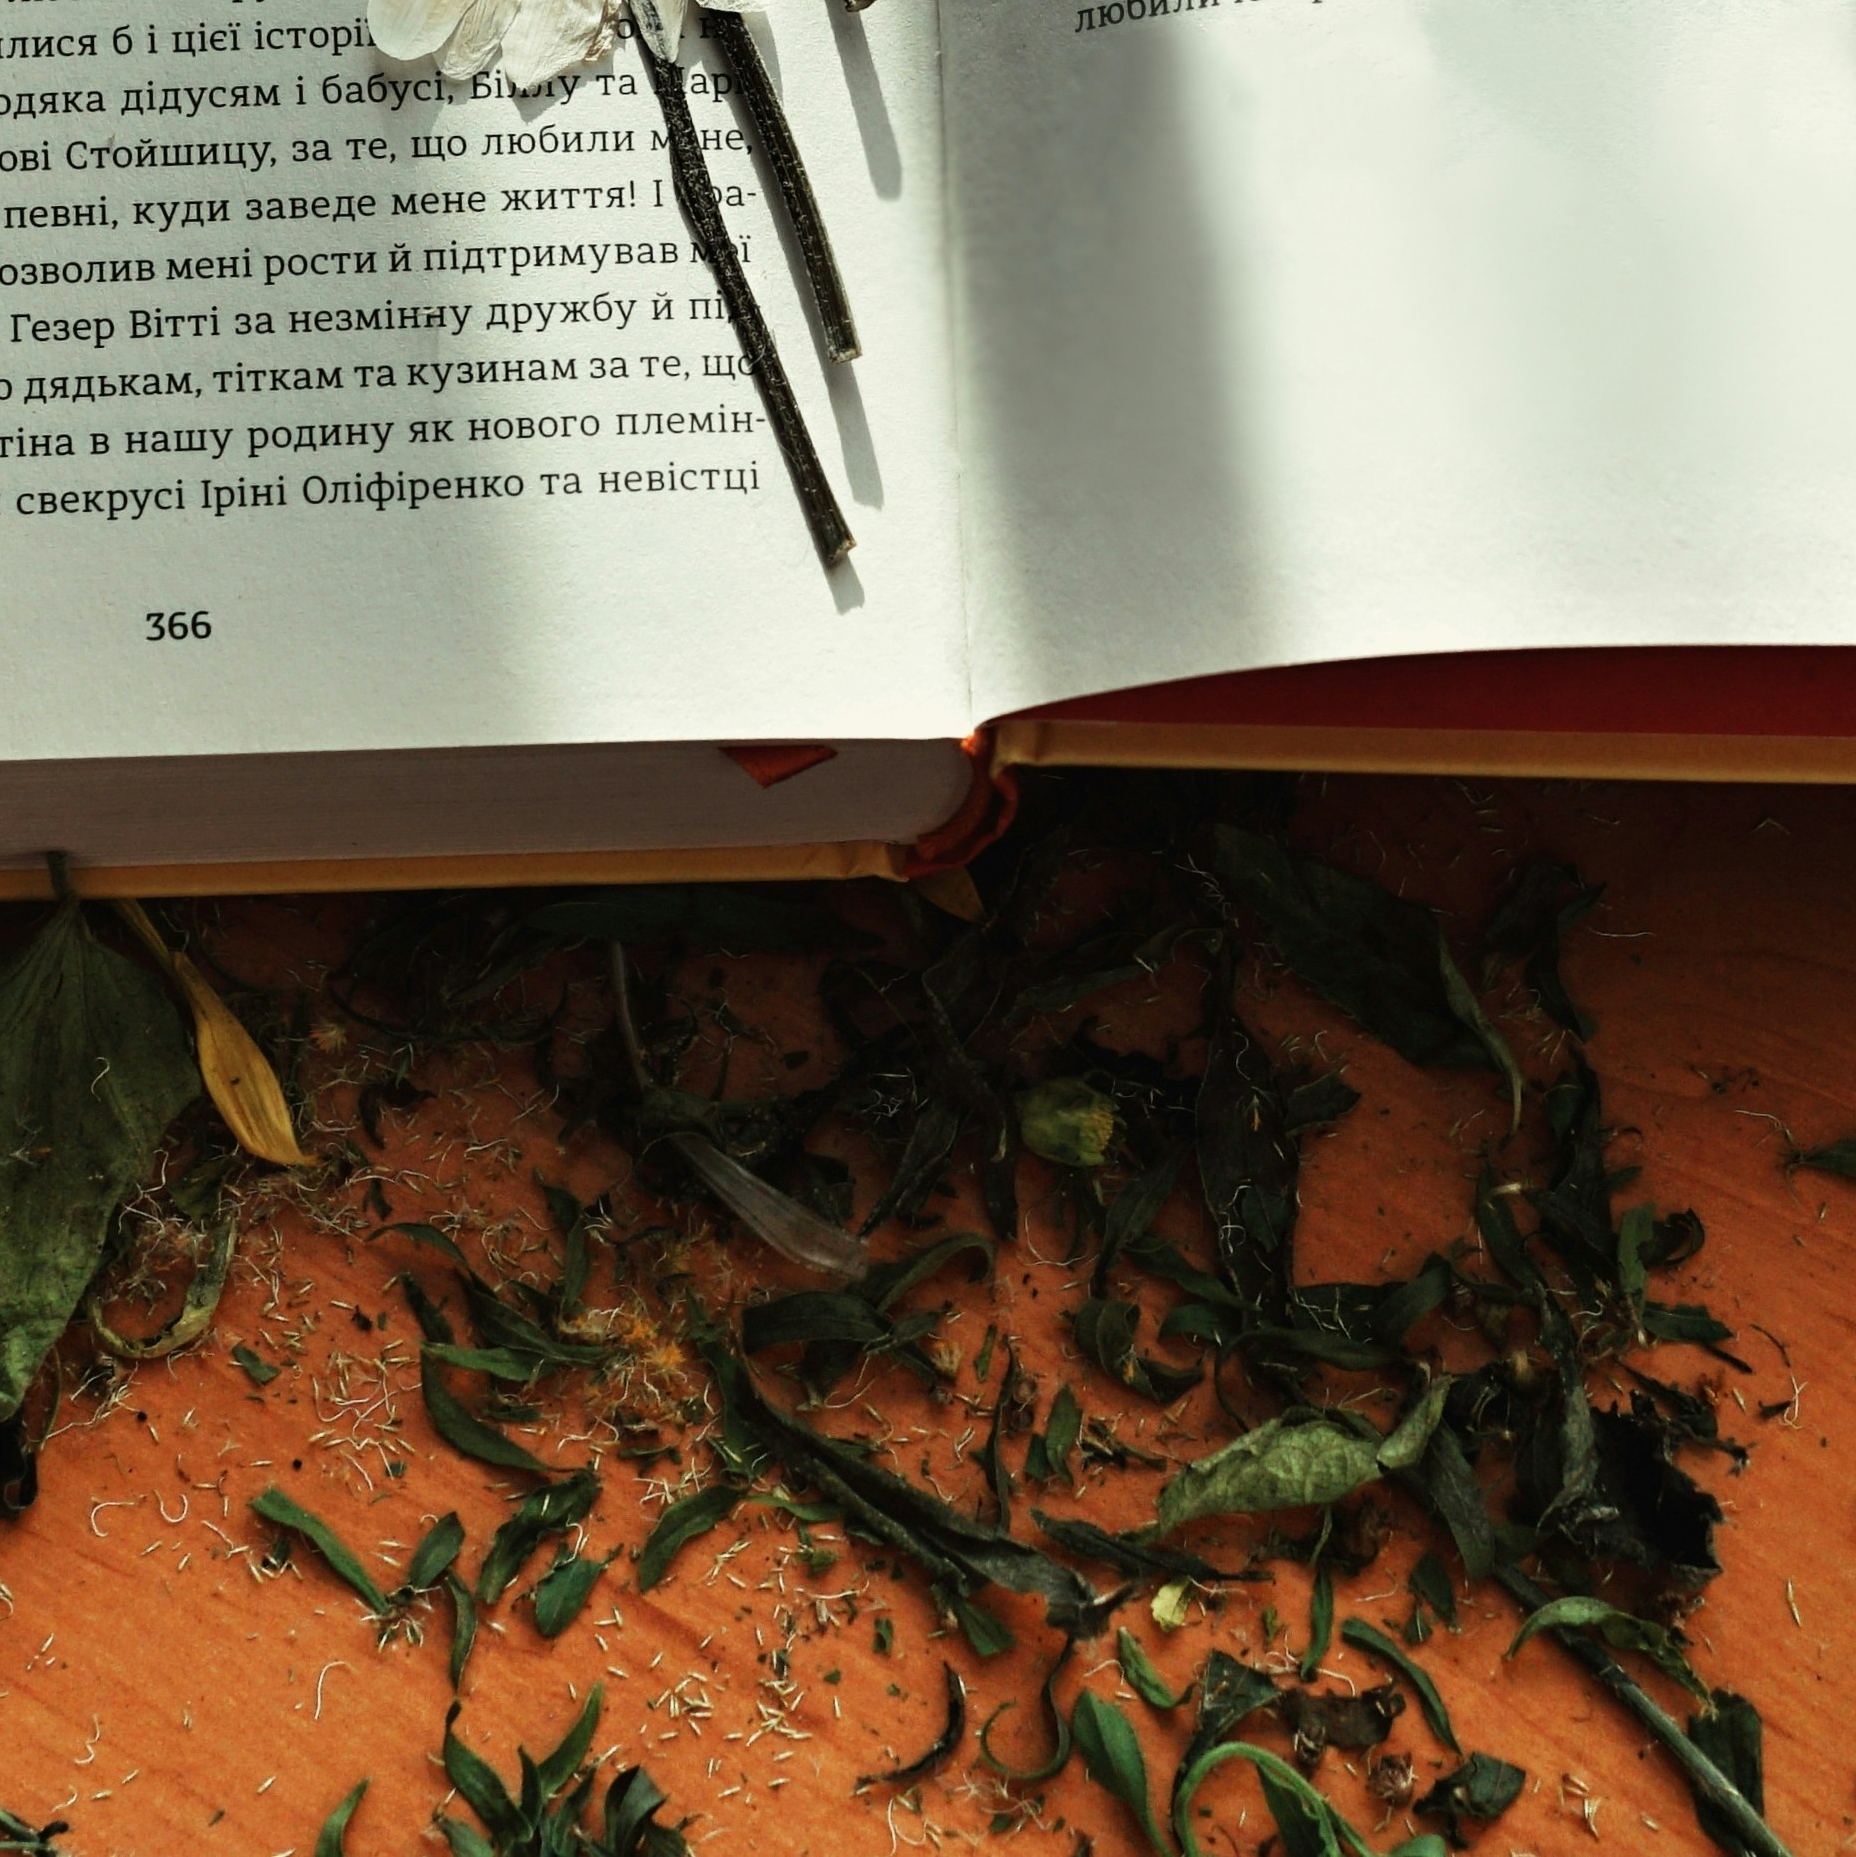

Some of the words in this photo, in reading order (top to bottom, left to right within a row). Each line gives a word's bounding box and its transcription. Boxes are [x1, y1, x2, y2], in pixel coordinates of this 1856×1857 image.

[65, 135, 278, 174] Стойшицу,
[291, 138, 333, 163] за
[344, 137, 397, 164] те,
[410, 134, 468, 163] що
[480, 123, 636, 157] любили
[88, 432, 111, 456] в
[124, 427, 235, 461] нашу
[246, 421, 396, 459] родину
[408, 418, 455, 444] як
[467, 414, 601, 442] нового
[615, 403, 766, 436] племін-
[15, 478, 186, 522] свекрусі
[200, 474, 288, 518] Іріні
[301, 469, 525, 513] Оліфіренко
[538, 472, 583, 496] та
[598, 459, 760, 495] невістці
[146, 610, 211, 641] 366
